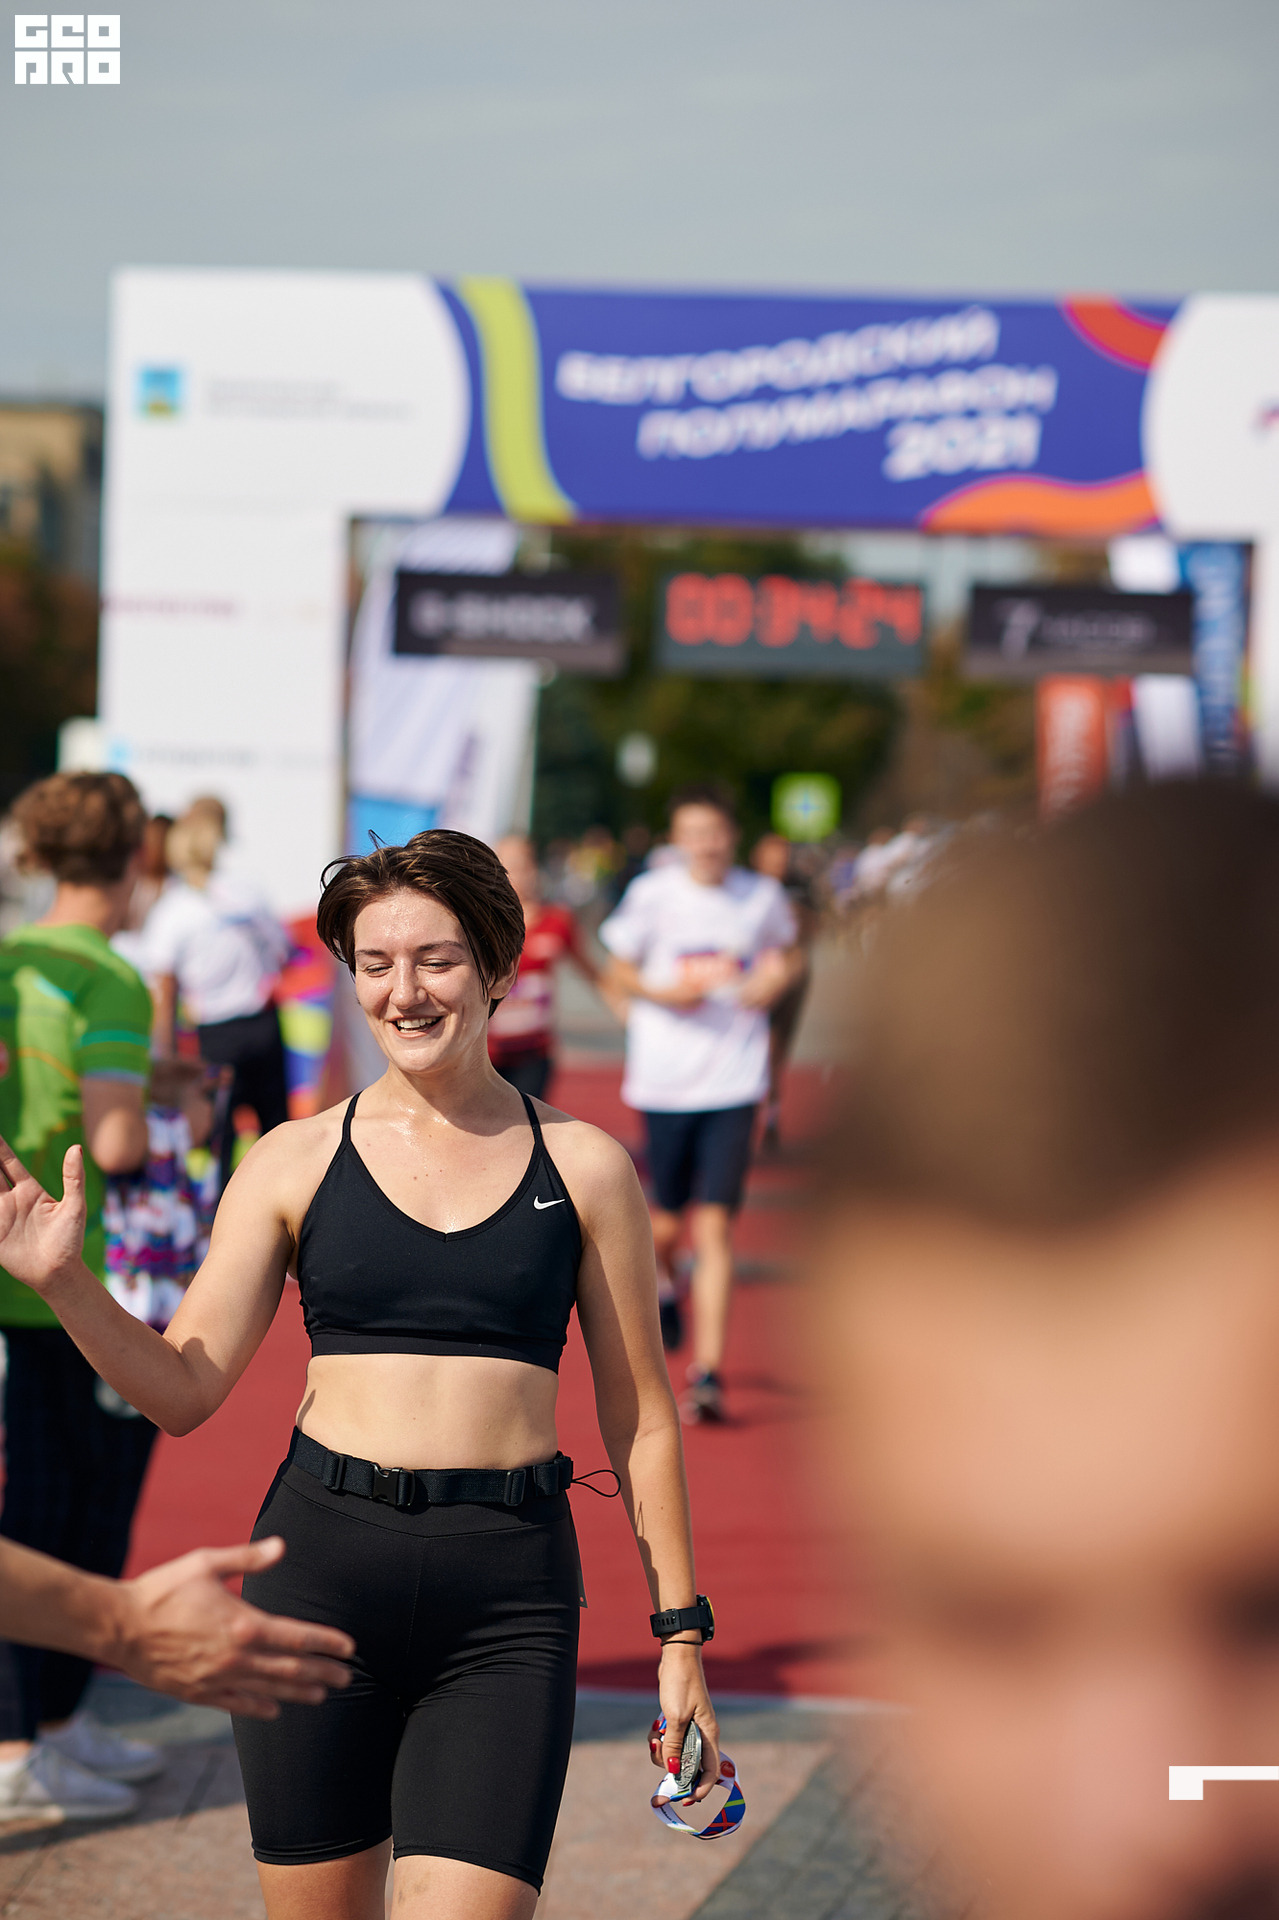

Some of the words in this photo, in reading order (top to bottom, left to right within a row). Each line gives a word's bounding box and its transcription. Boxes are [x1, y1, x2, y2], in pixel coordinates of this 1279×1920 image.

[556, 306, 1000, 405] БЕЛГОРОДСКИЙ
[636, 364, 1058, 460] ПОЛУМАРАФОН
[882, 412, 1042, 482] 2021
